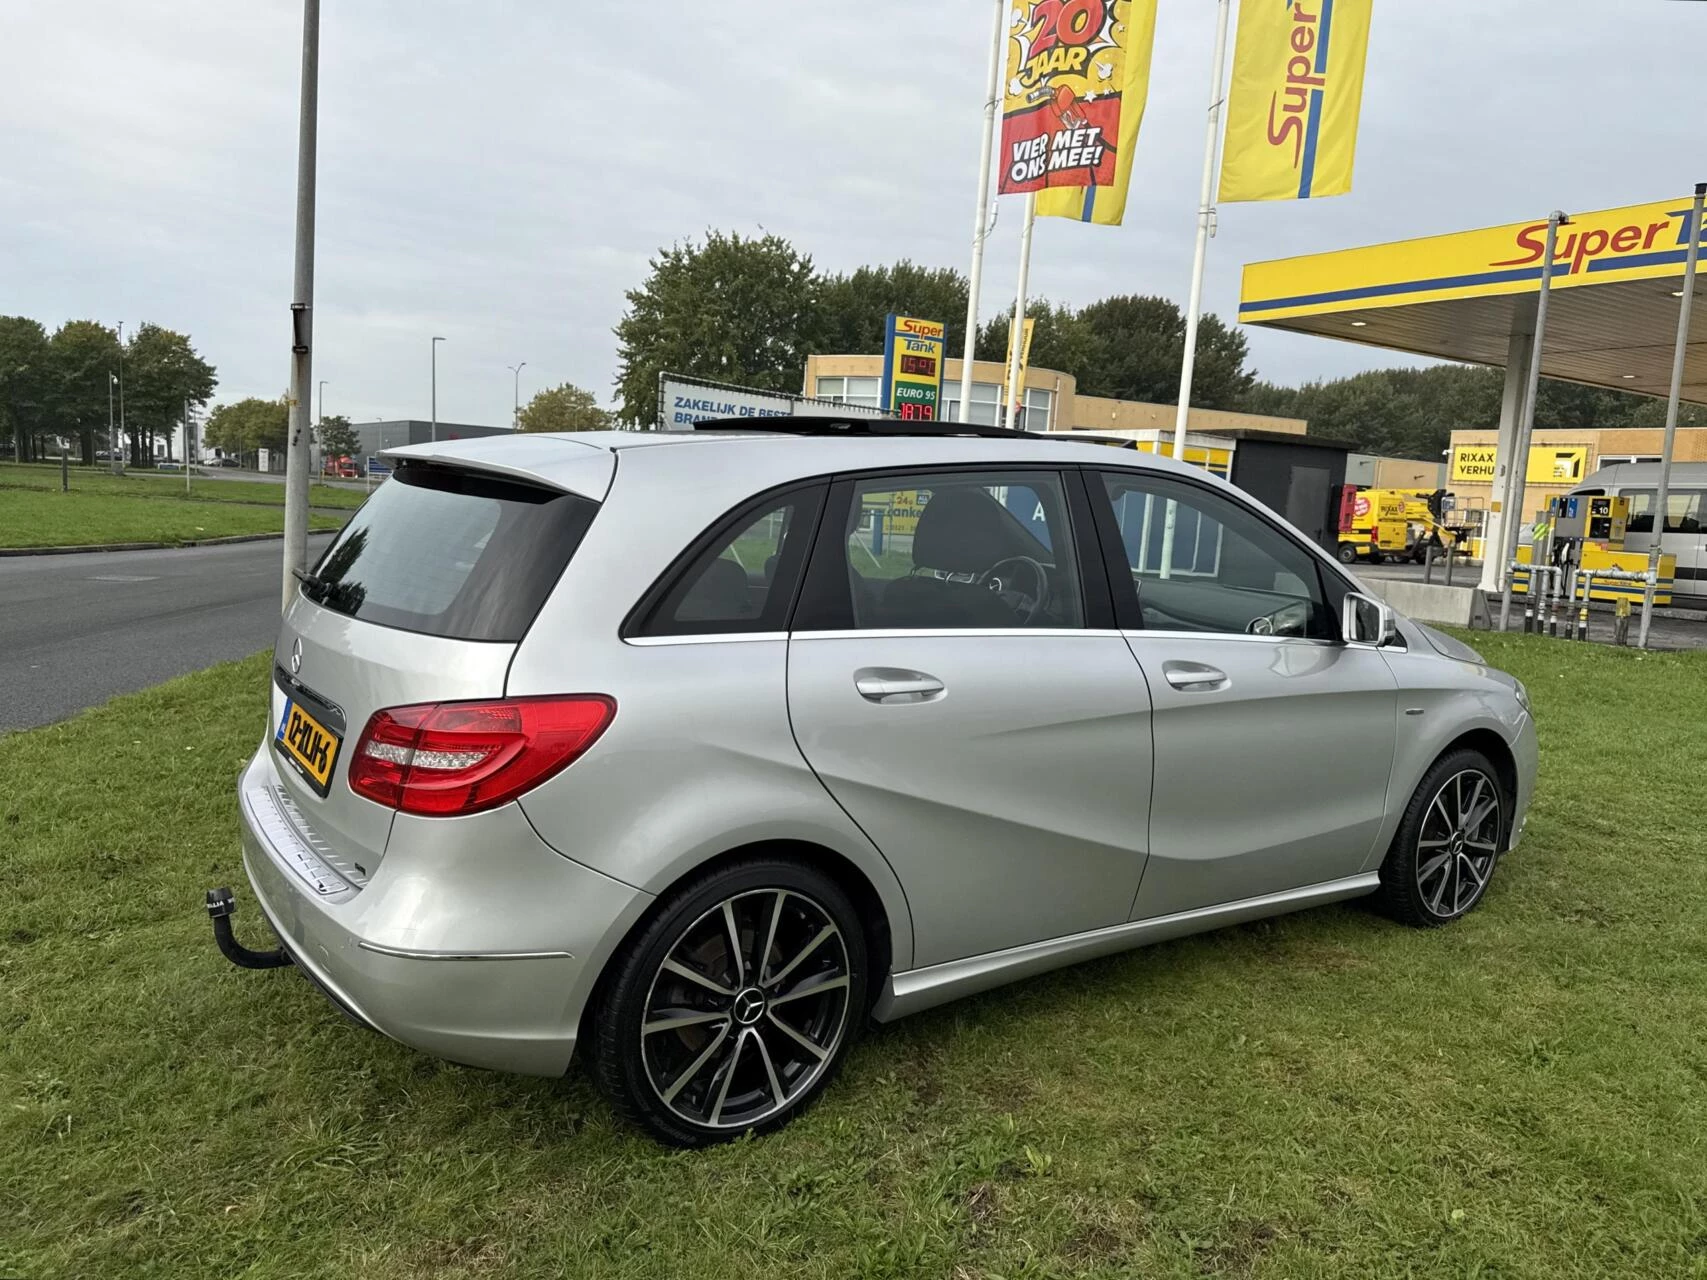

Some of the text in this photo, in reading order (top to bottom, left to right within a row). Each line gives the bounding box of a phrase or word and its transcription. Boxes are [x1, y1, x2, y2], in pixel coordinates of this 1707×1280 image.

[1029, 0, 1104, 57] 20
[1020, 47, 1087, 86] JAAR
[1267, 2, 1325, 169] Super
[1013, 127, 1101, 161] VIER MET
[1011, 146, 1103, 181] ONS MEE!
[1489, 221, 1670, 274] Super
[897, 319, 943, 340] Super
[903, 339, 935, 354] Tank
[674, 396, 736, 415] ZAKELIJK
[739, 406, 756, 417] DE
[896, 387, 936, 400] EURO 95
[1460, 453, 1494, 463] RIXAX
[1460, 465, 1495, 475] VERHU
